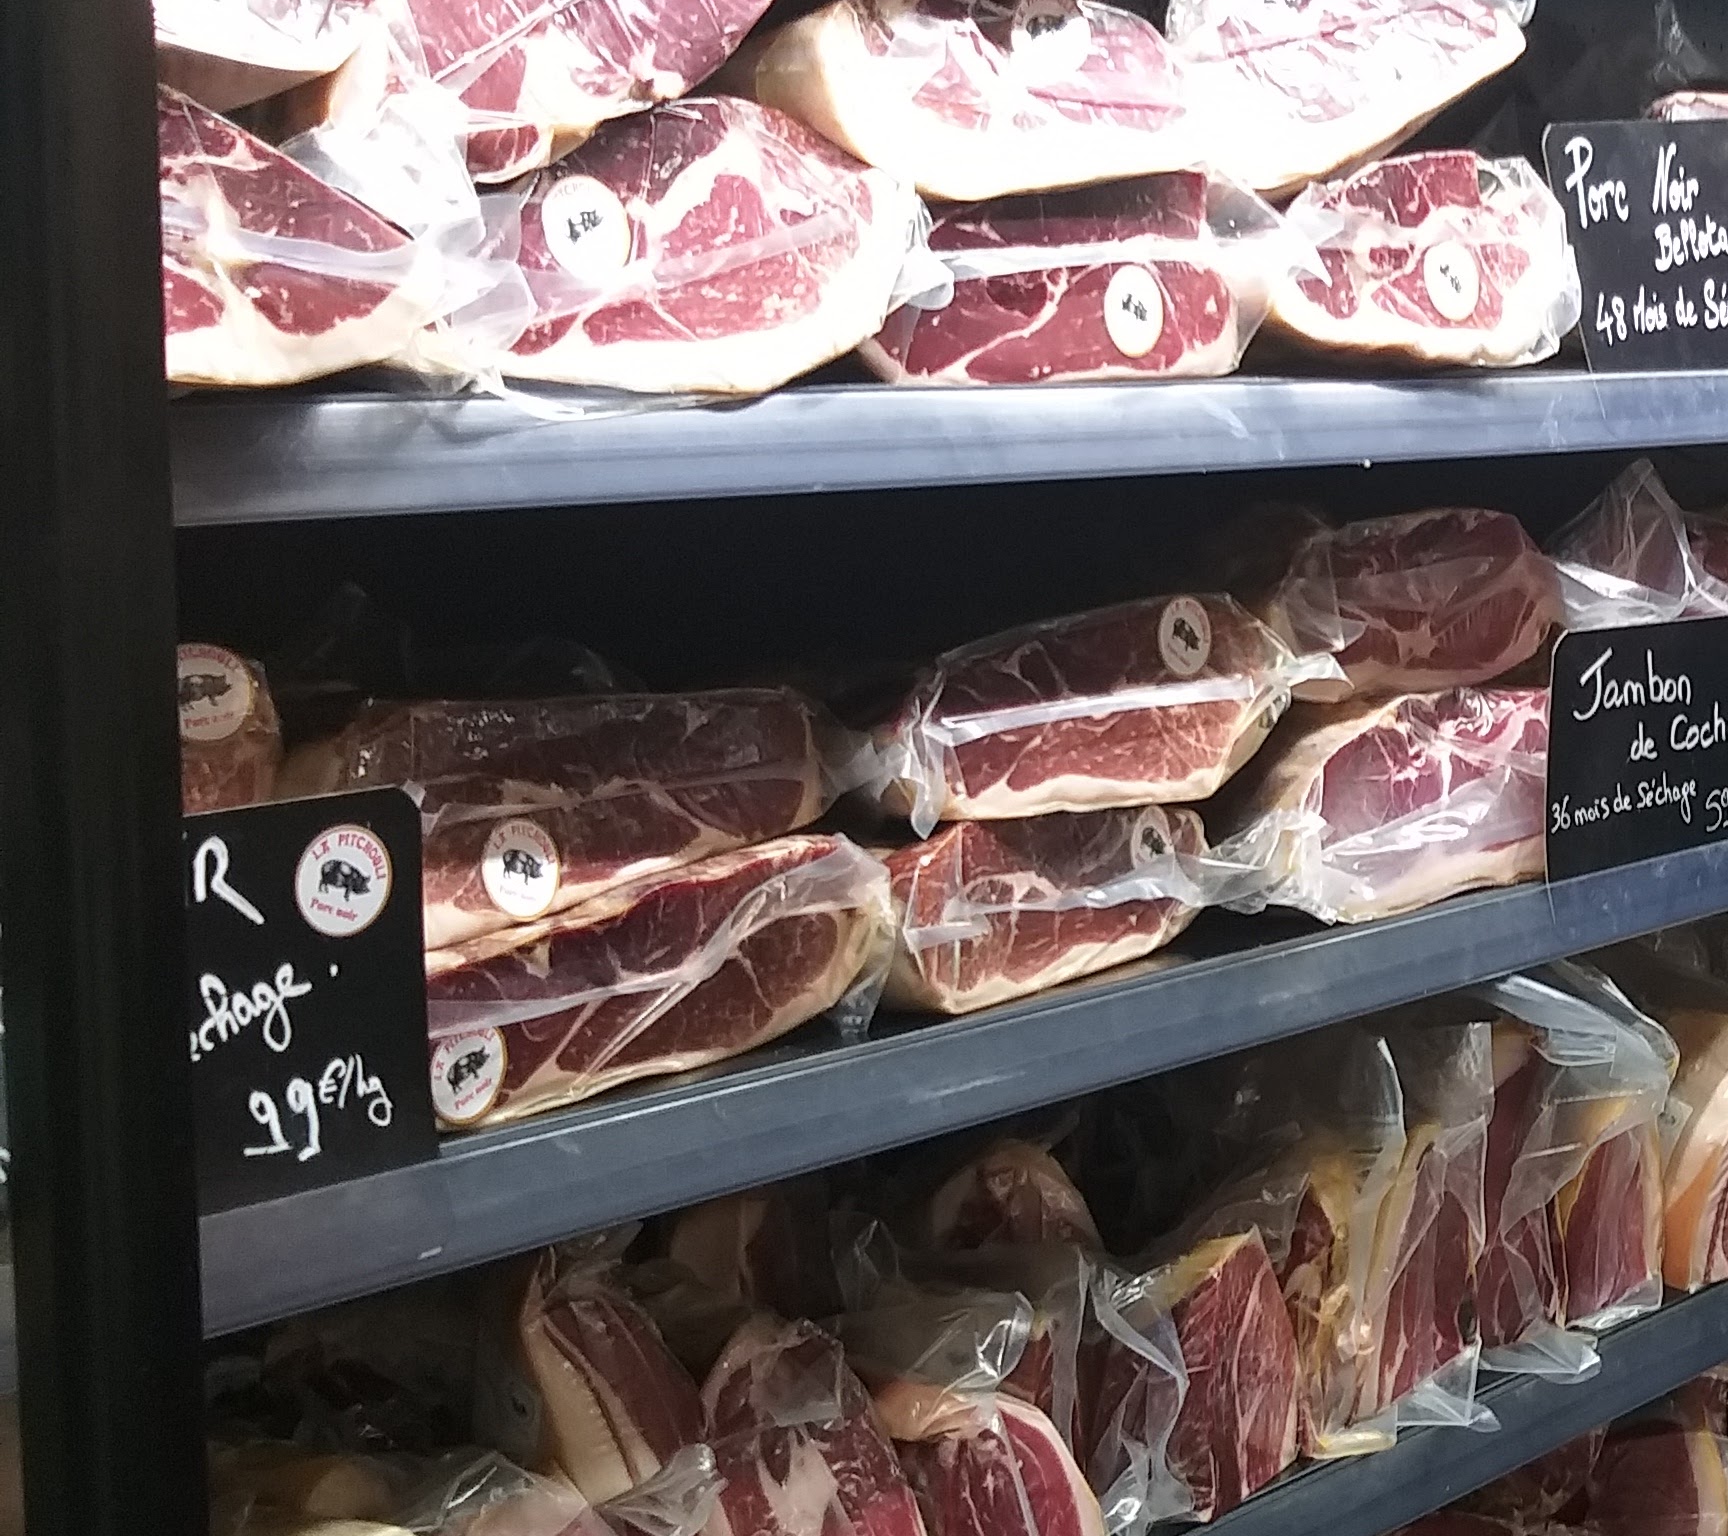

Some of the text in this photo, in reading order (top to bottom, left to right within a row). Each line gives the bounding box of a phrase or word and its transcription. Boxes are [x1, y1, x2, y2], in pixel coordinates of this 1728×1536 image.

[1565, 136, 1699, 229] Porc Noir
[1596, 291, 1627, 346] 48
[1675, 286, 1698, 326] de
[1573, 647, 1692, 721] Jambon
[1630, 721, 1658, 760] de
[1551, 795, 1570, 834] 36
[1575, 797, 1610, 826] mois
[1614, 783, 1632, 813] de
